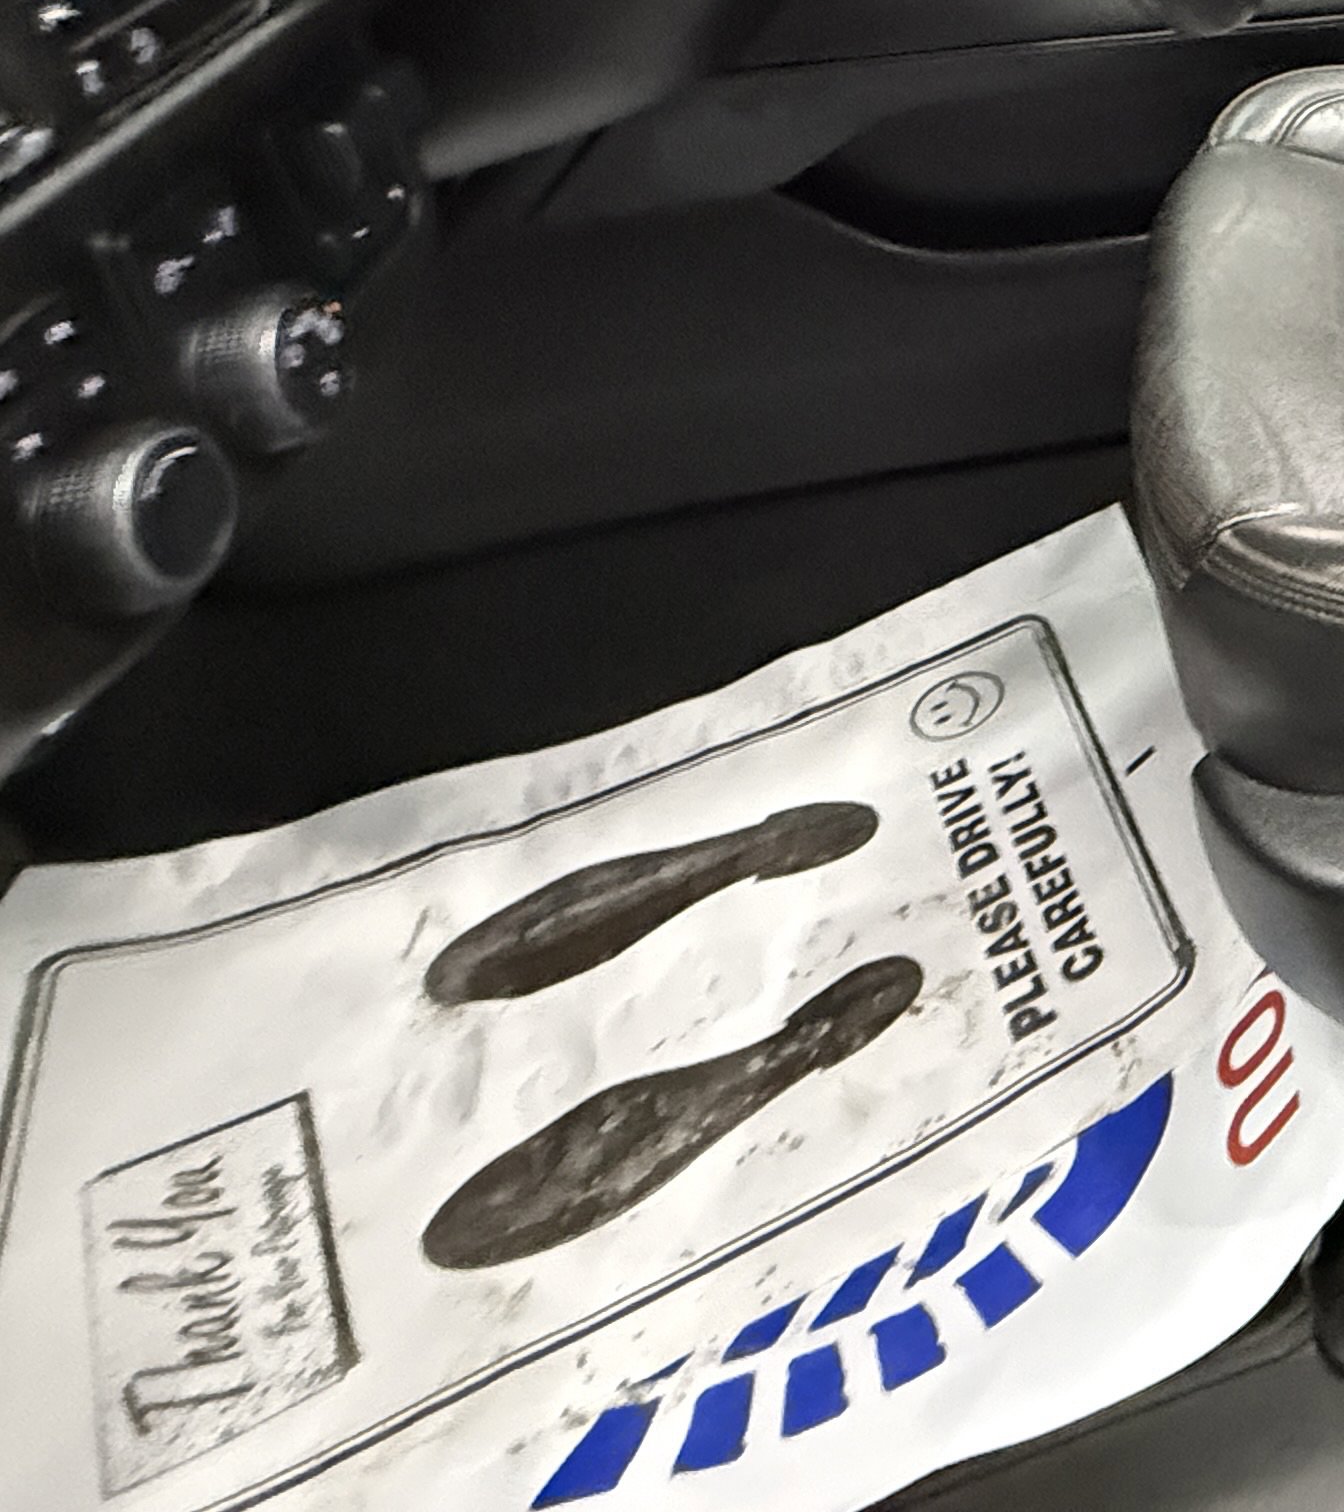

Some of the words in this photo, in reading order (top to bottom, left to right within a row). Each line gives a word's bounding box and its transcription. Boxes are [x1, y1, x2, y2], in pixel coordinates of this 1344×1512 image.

[929, 757, 1000, 879] DRIVE
[987, 749, 1104, 983] CAREFULLY!
[966, 872, 1058, 1044] PLEASE
[105, 1155, 238, 1249] You
[120, 1249, 257, 1436] Thank
